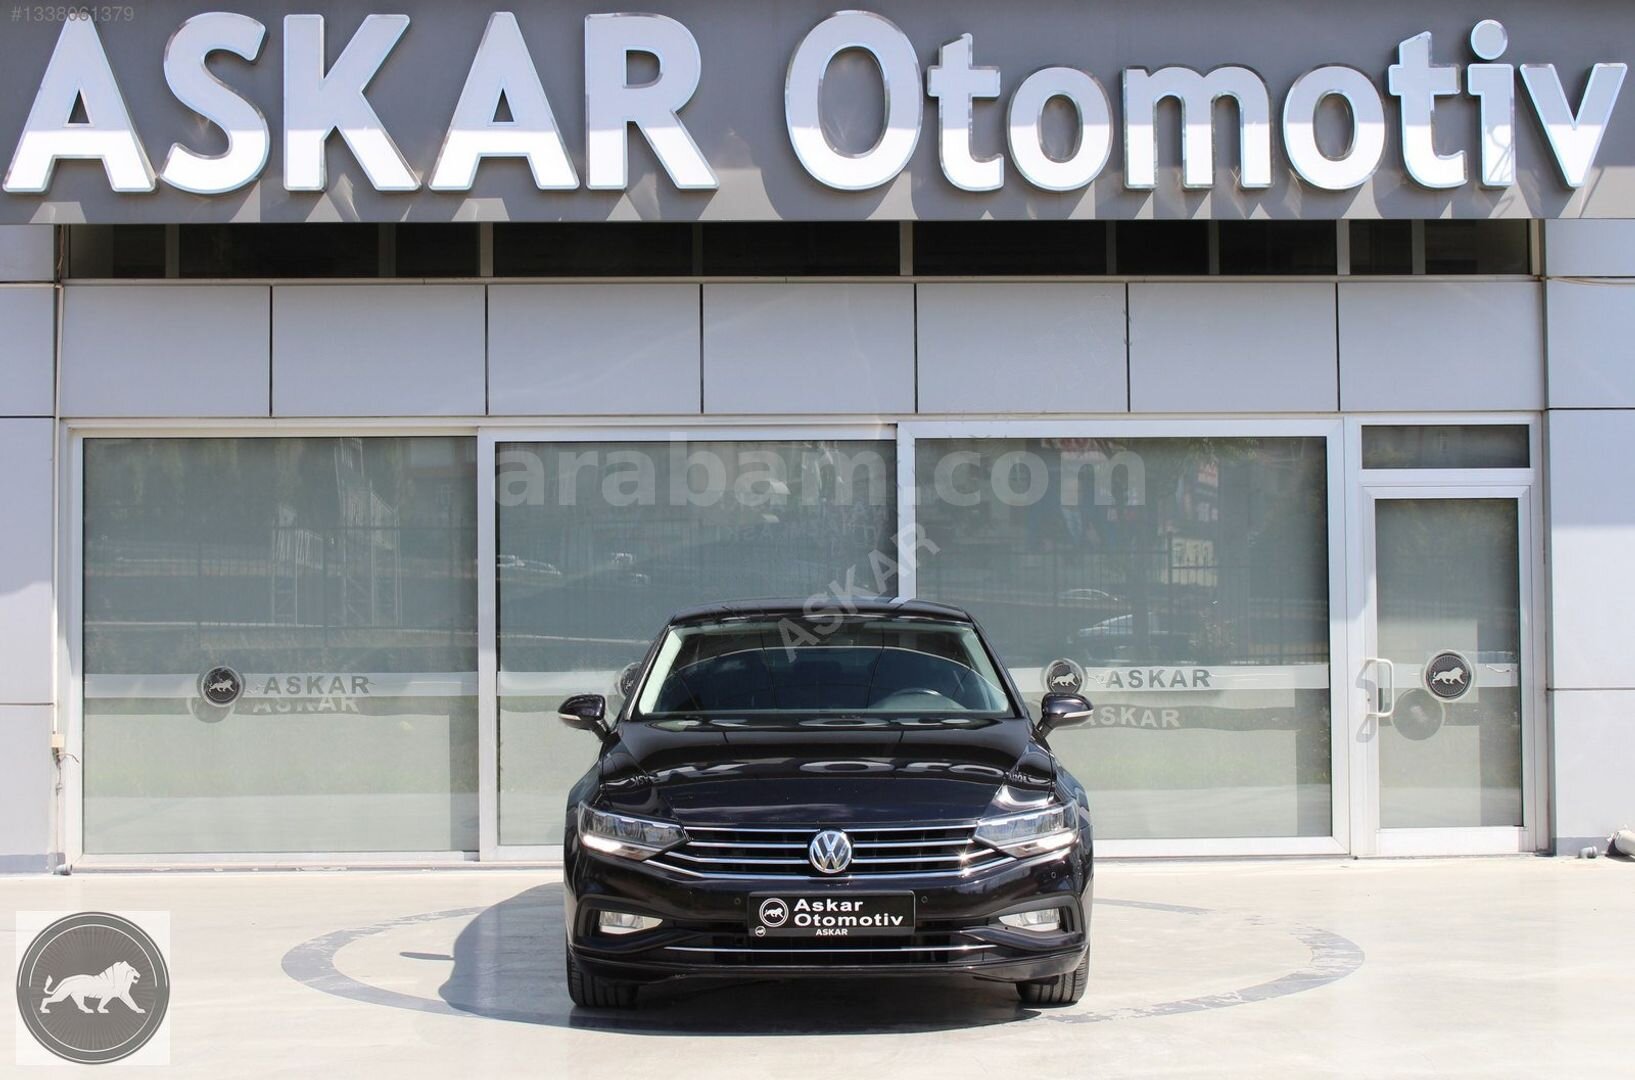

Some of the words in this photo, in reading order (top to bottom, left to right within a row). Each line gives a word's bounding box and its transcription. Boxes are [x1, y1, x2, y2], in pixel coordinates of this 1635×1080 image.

[3, 10, 720, 194] ASKAR
[784, 9, 1629, 191] Otomotiv
[263, 675, 370, 695] ASKAR
[1105, 669, 1211, 689] ASKAR
[793, 898, 864, 912] Askar
[793, 913, 904, 927] Otomotiv
[815, 928, 848, 937] ASKAR
